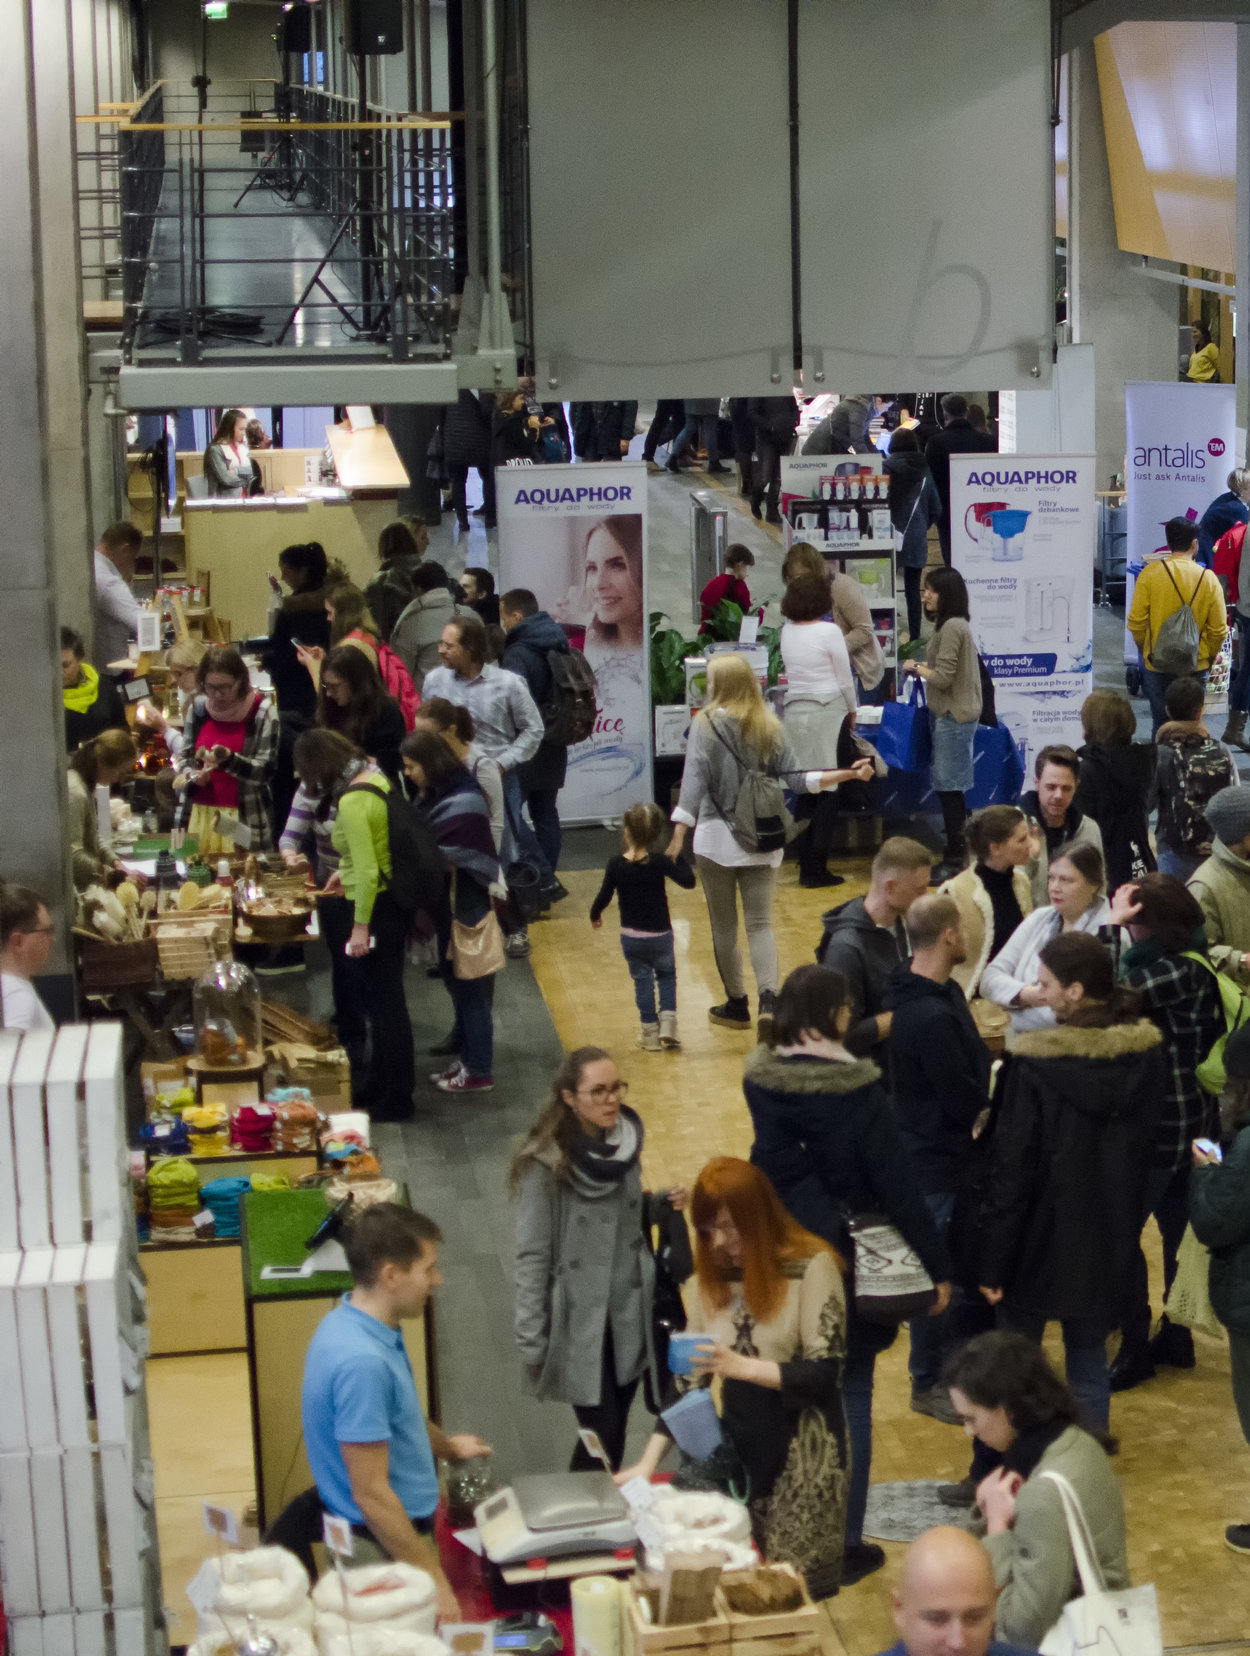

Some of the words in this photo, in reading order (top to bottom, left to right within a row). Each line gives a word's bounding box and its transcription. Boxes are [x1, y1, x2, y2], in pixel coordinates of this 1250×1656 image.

[1134, 442, 1206, 469] antalis
[966, 470, 1078, 486] AQUAPHOR
[1134, 472, 1152, 480] Just
[1155, 472, 1171, 480] ask
[1174, 472, 1206, 483] Antalis
[514, 486, 632, 506] AQUAPHOR
[1038, 500, 1057, 508] Filtry
[990, 657, 1004, 666] do
[1006, 656, 1032, 667] wody
[1013, 666, 1047, 674] Premium
[998, 679, 1084, 688] www.aquaphor.pl
